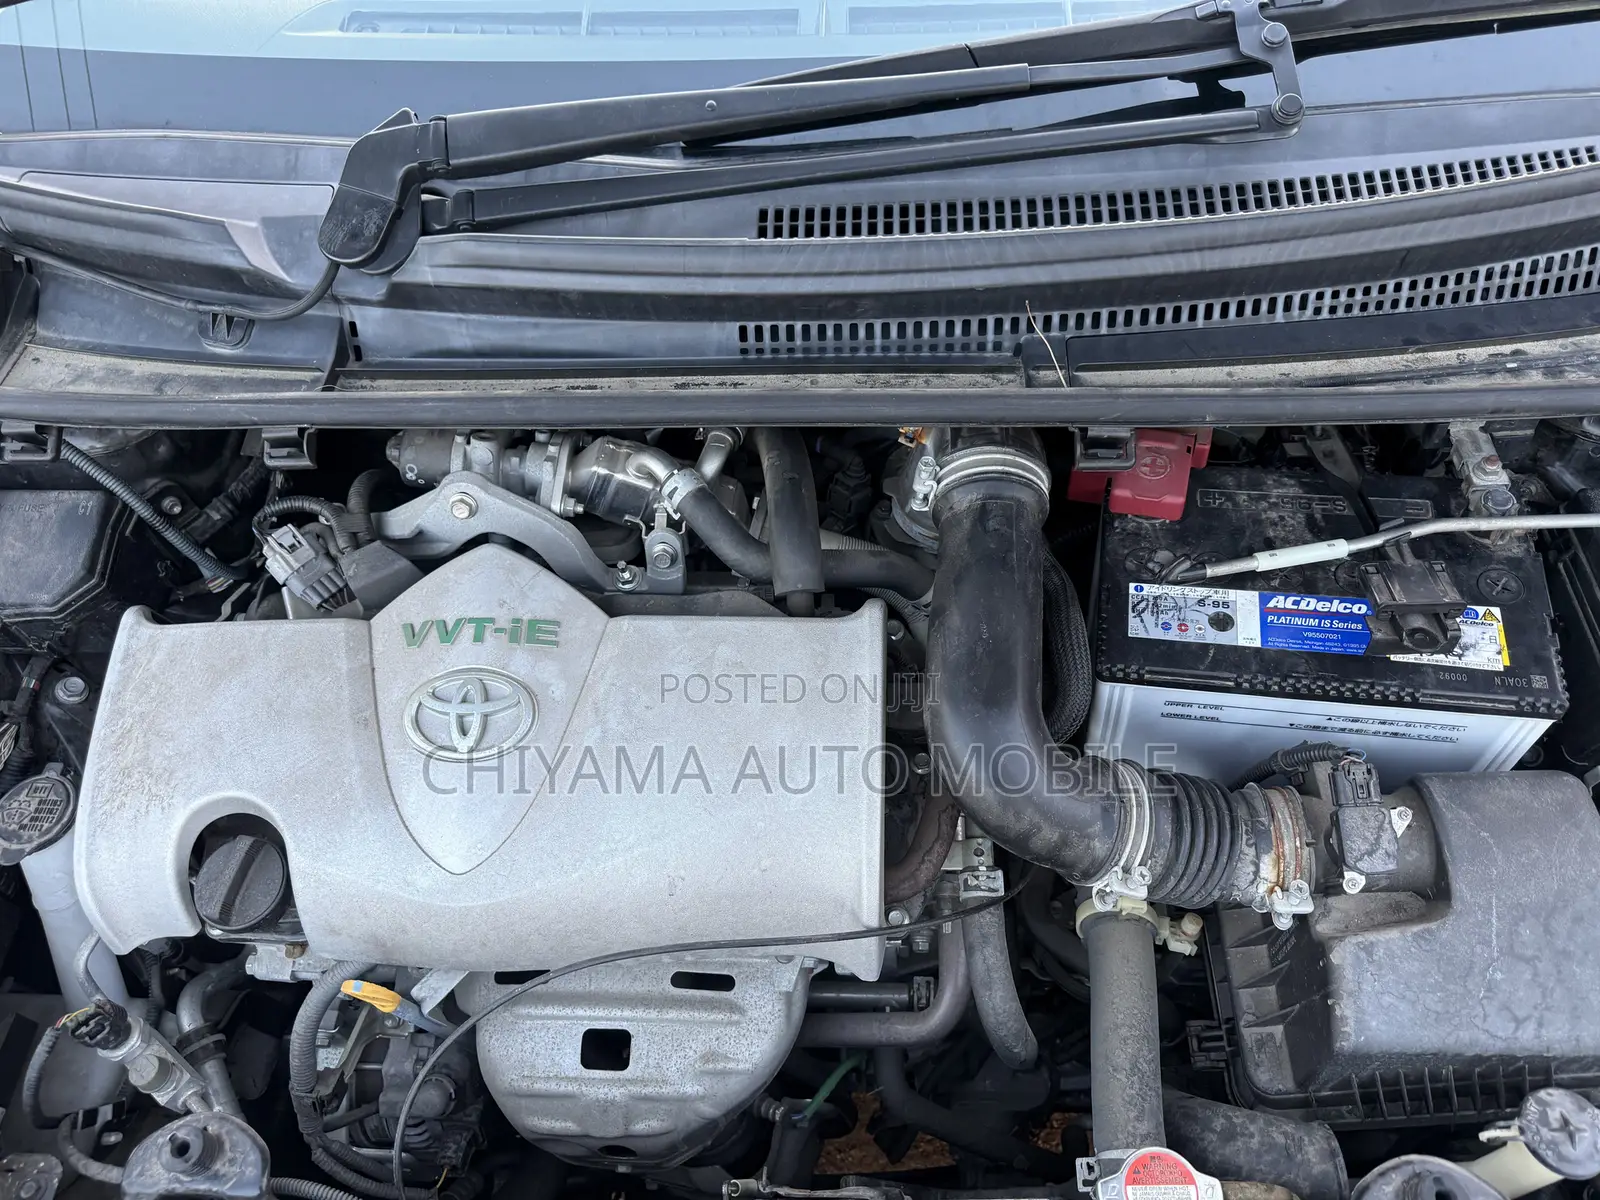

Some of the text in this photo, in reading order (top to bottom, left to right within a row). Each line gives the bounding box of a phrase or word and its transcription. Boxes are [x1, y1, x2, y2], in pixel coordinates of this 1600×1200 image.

[1198, 600, 1230, 609] S-95
[1266, 595, 1368, 615] ACDelco
[1267, 615, 1363, 630] PLATINUM IS Series
[401, 617, 561, 649] VVT-iE
[1132, 1177, 1187, 1185] AVERTISSEMENT
